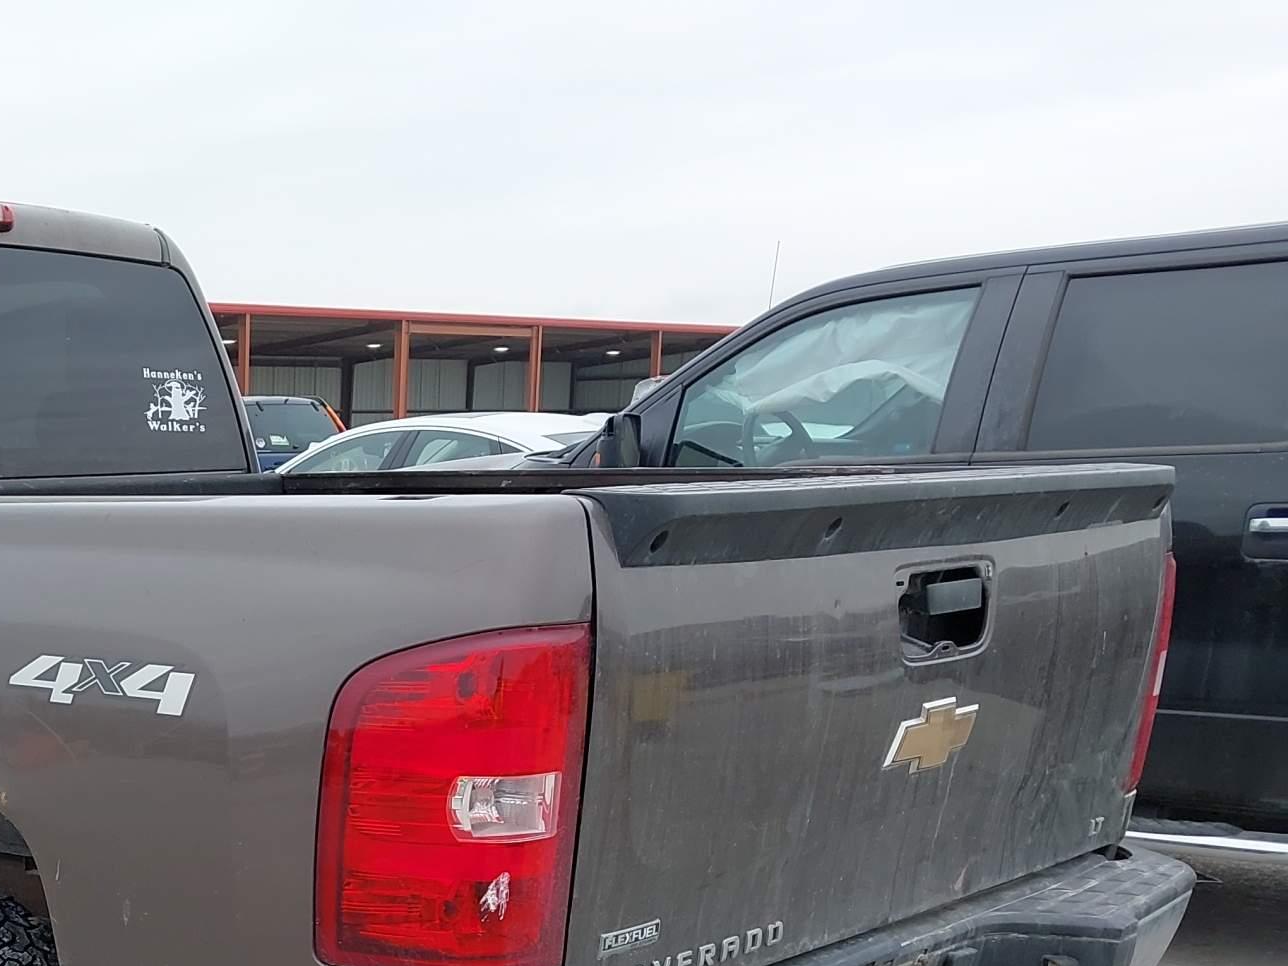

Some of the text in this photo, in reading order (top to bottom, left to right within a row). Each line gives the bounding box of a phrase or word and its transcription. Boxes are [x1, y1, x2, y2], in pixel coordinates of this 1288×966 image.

[143, 367, 202, 381] Hanneken's
[147, 421, 206, 432] Walker's
[604, 924, 659, 950] FLEXFUEL
